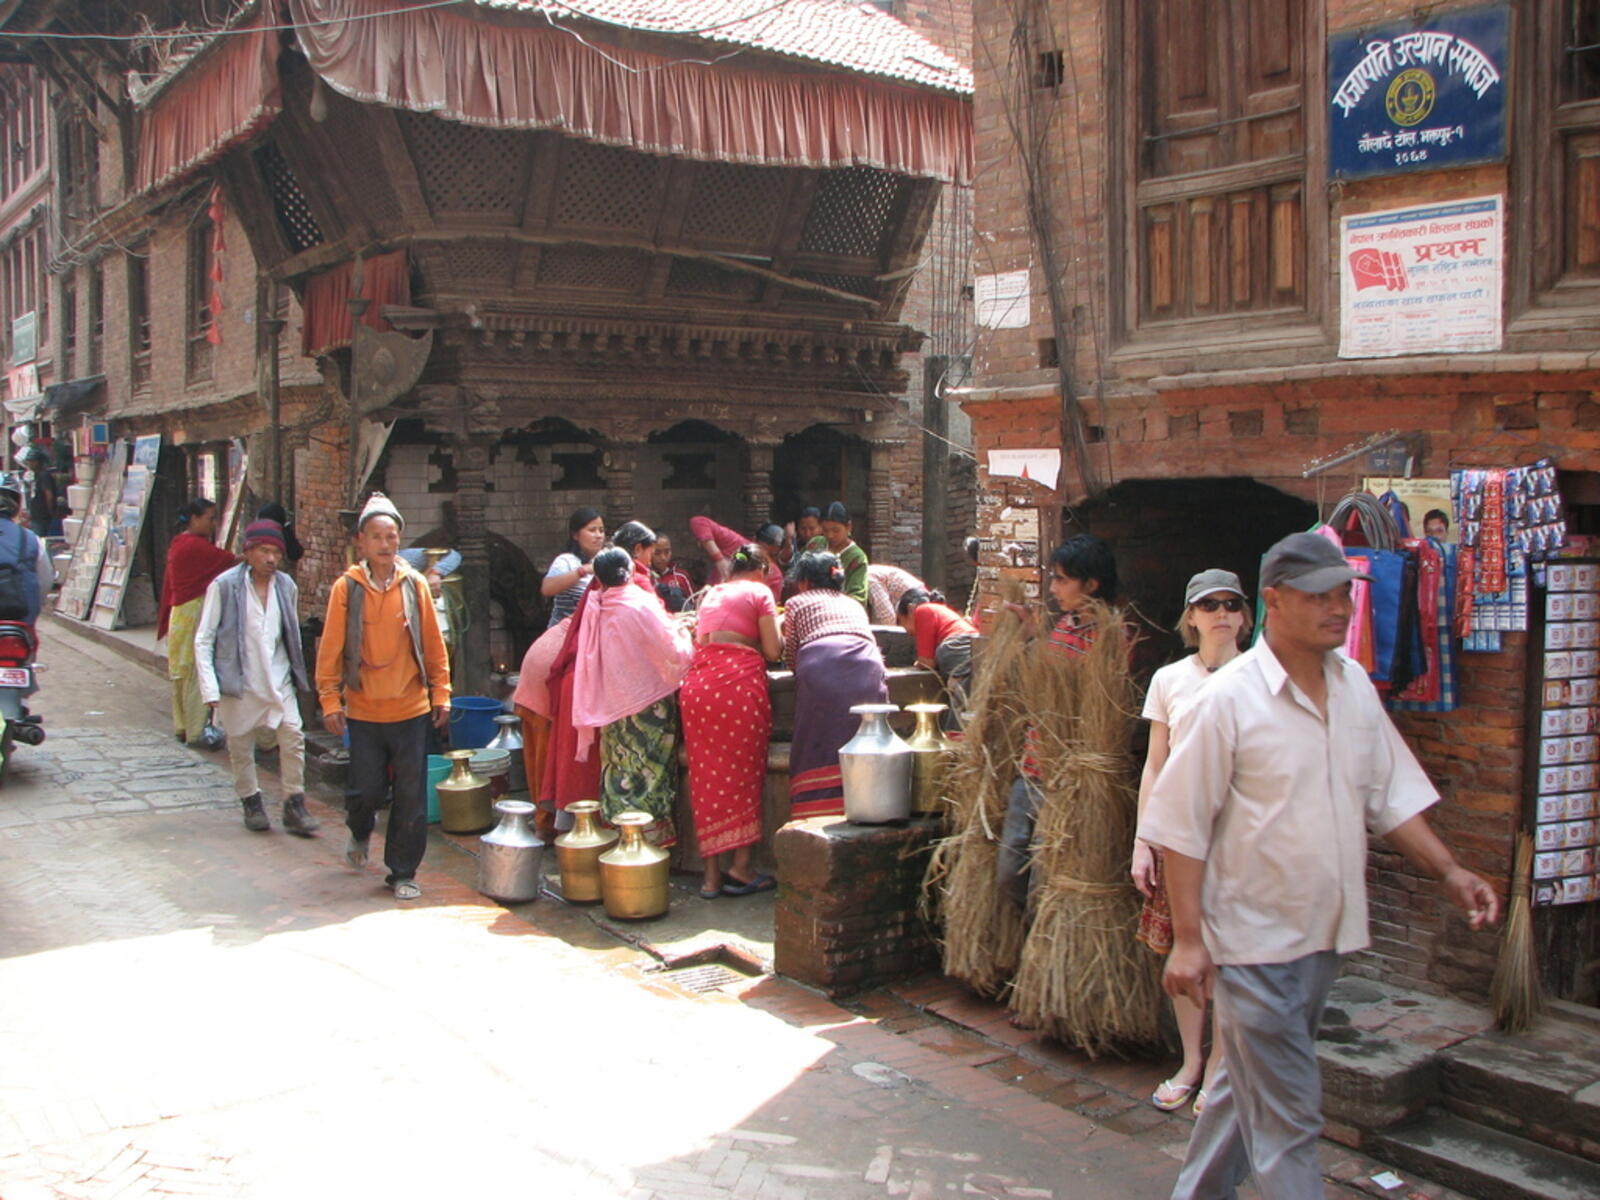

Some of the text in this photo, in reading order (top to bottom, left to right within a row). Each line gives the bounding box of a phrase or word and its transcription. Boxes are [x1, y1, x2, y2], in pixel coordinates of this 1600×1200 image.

[1332, 40, 1392, 118] प्रजापति
[1393, 32, 1453, 67] उत्थान
[1449, 38, 1500, 100] समाज
[1413, 238, 1487, 263] प्रथम
